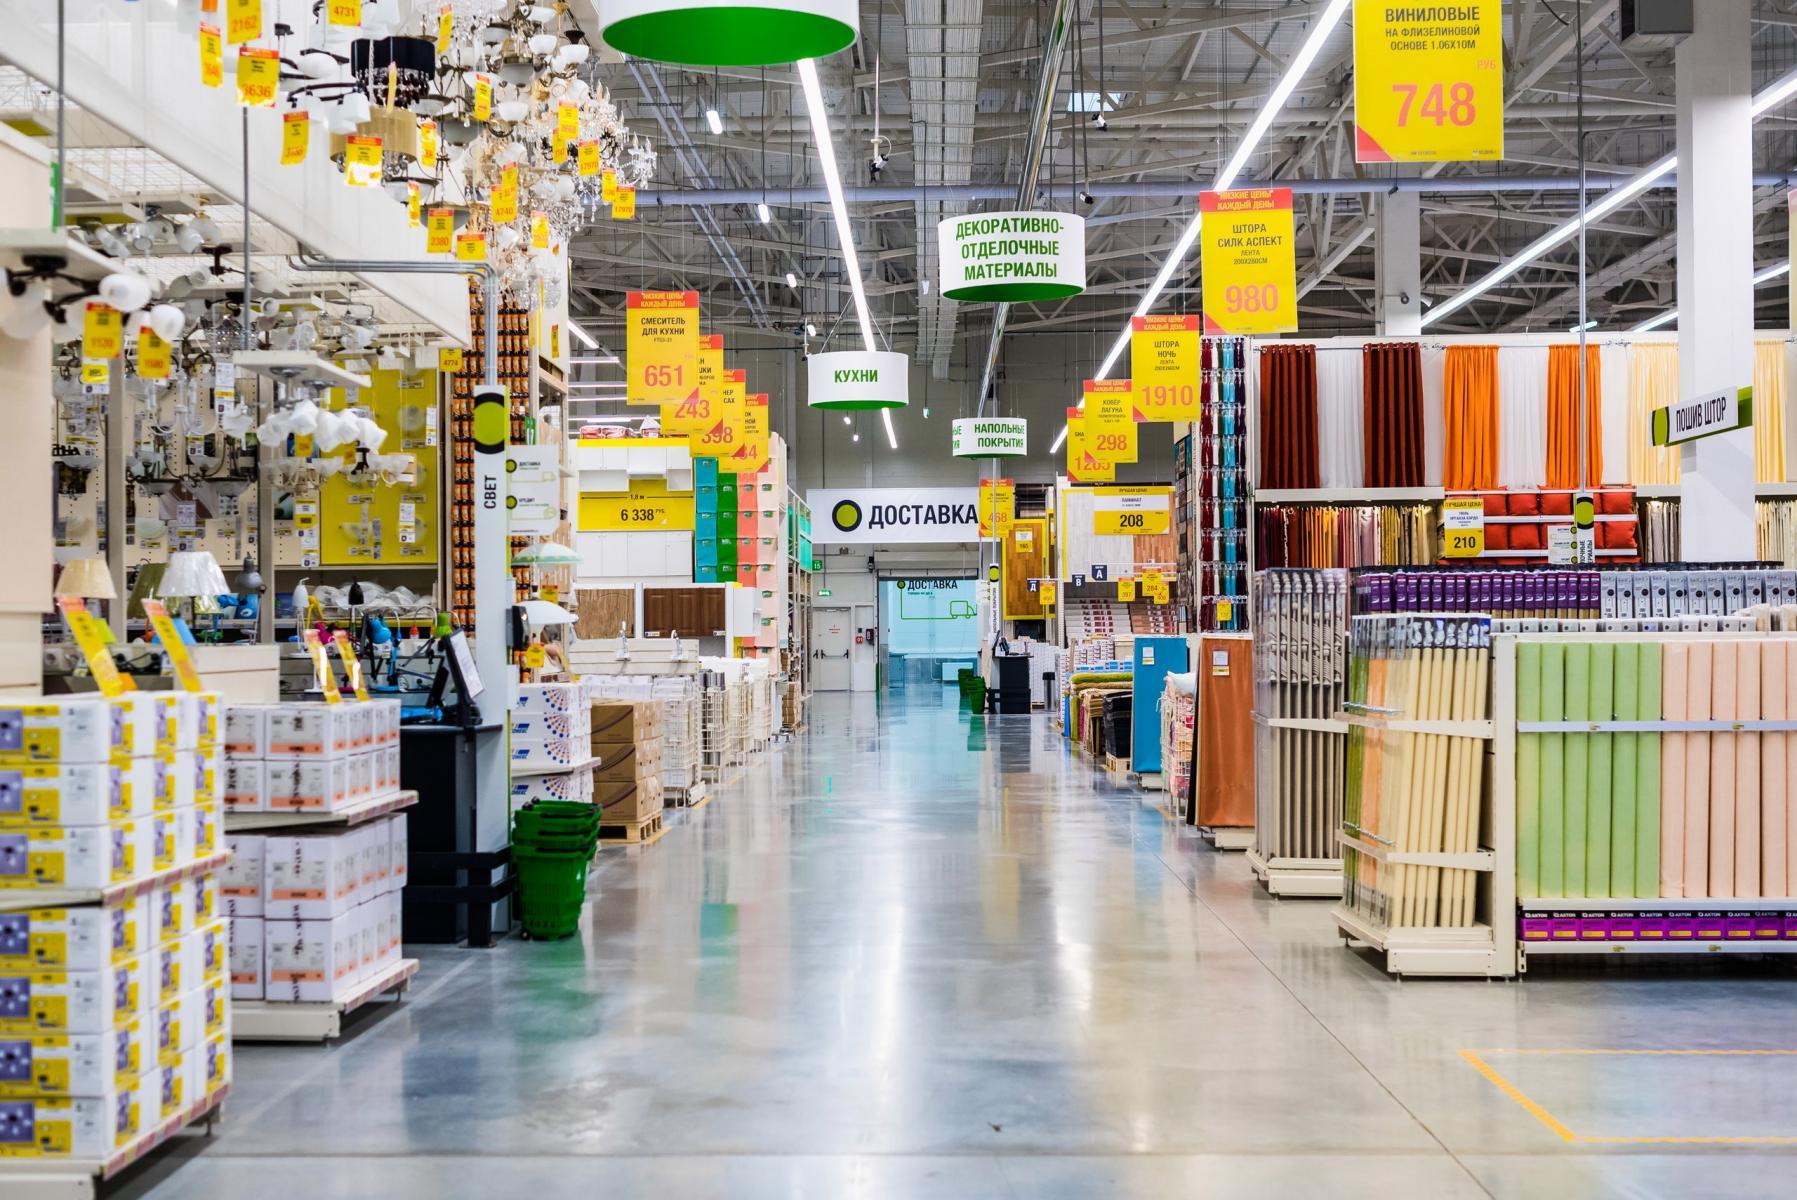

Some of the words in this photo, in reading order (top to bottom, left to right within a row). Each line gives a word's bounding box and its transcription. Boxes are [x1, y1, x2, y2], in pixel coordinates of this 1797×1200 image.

[334, 6, 355, 16] 4731
[1385, 7, 1480, 22] ВИНИЛОВЫЕ
[1385, 28, 1398, 37] НА
[1401, 25, 1480, 37] ФЛИЗЕЛИНОВОЙ
[1390, 41, 1427, 50] ОСНОВЕ
[1477, 59, 1496, 70] РУБ
[1392, 82, 1476, 127] 748
[956, 218, 1064, 240] ДЕКОРАТИВНО-
[1232, 223, 1267, 234] ШТОРА
[1218, 238, 1243, 248] СИЛК
[1246, 236, 1283, 246] АСПЕКТ
[961, 240, 1060, 259] ОТДЕЛОЧНЫЕ
[964, 262, 1058, 281] МАТЕРИАЛЫ
[1225, 284, 1279, 314] 980
[641, 317, 686, 325] СМЕСИТЕЛЬ
[642, 328, 658, 336] ДЛЯ
[645, 364, 683, 387] 651
[834, 369, 878, 383] КУХНИ
[1142, 385, 1193, 406] 1910
[674, 399, 710, 418] 243
[1676, 404, 1702, 432] ПОШИВ
[1704, 396, 1726, 425] ШТОР
[974, 423, 1024, 434] НАПОЛЬНЫЕ
[978, 437, 1023, 448] ПОКРЫТИЯ
[1096, 435, 1127, 451] 298
[484, 475, 496, 509] СВЕТ
[621, 509, 628, 521] 6
[632, 509, 654, 521] 338
[868, 504, 978, 529] ДОСТАВКА
[1120, 514, 1144, 527] 208
[1454, 536, 1476, 548] 210
[907, 579, 958, 590] ДОСТАВКА
